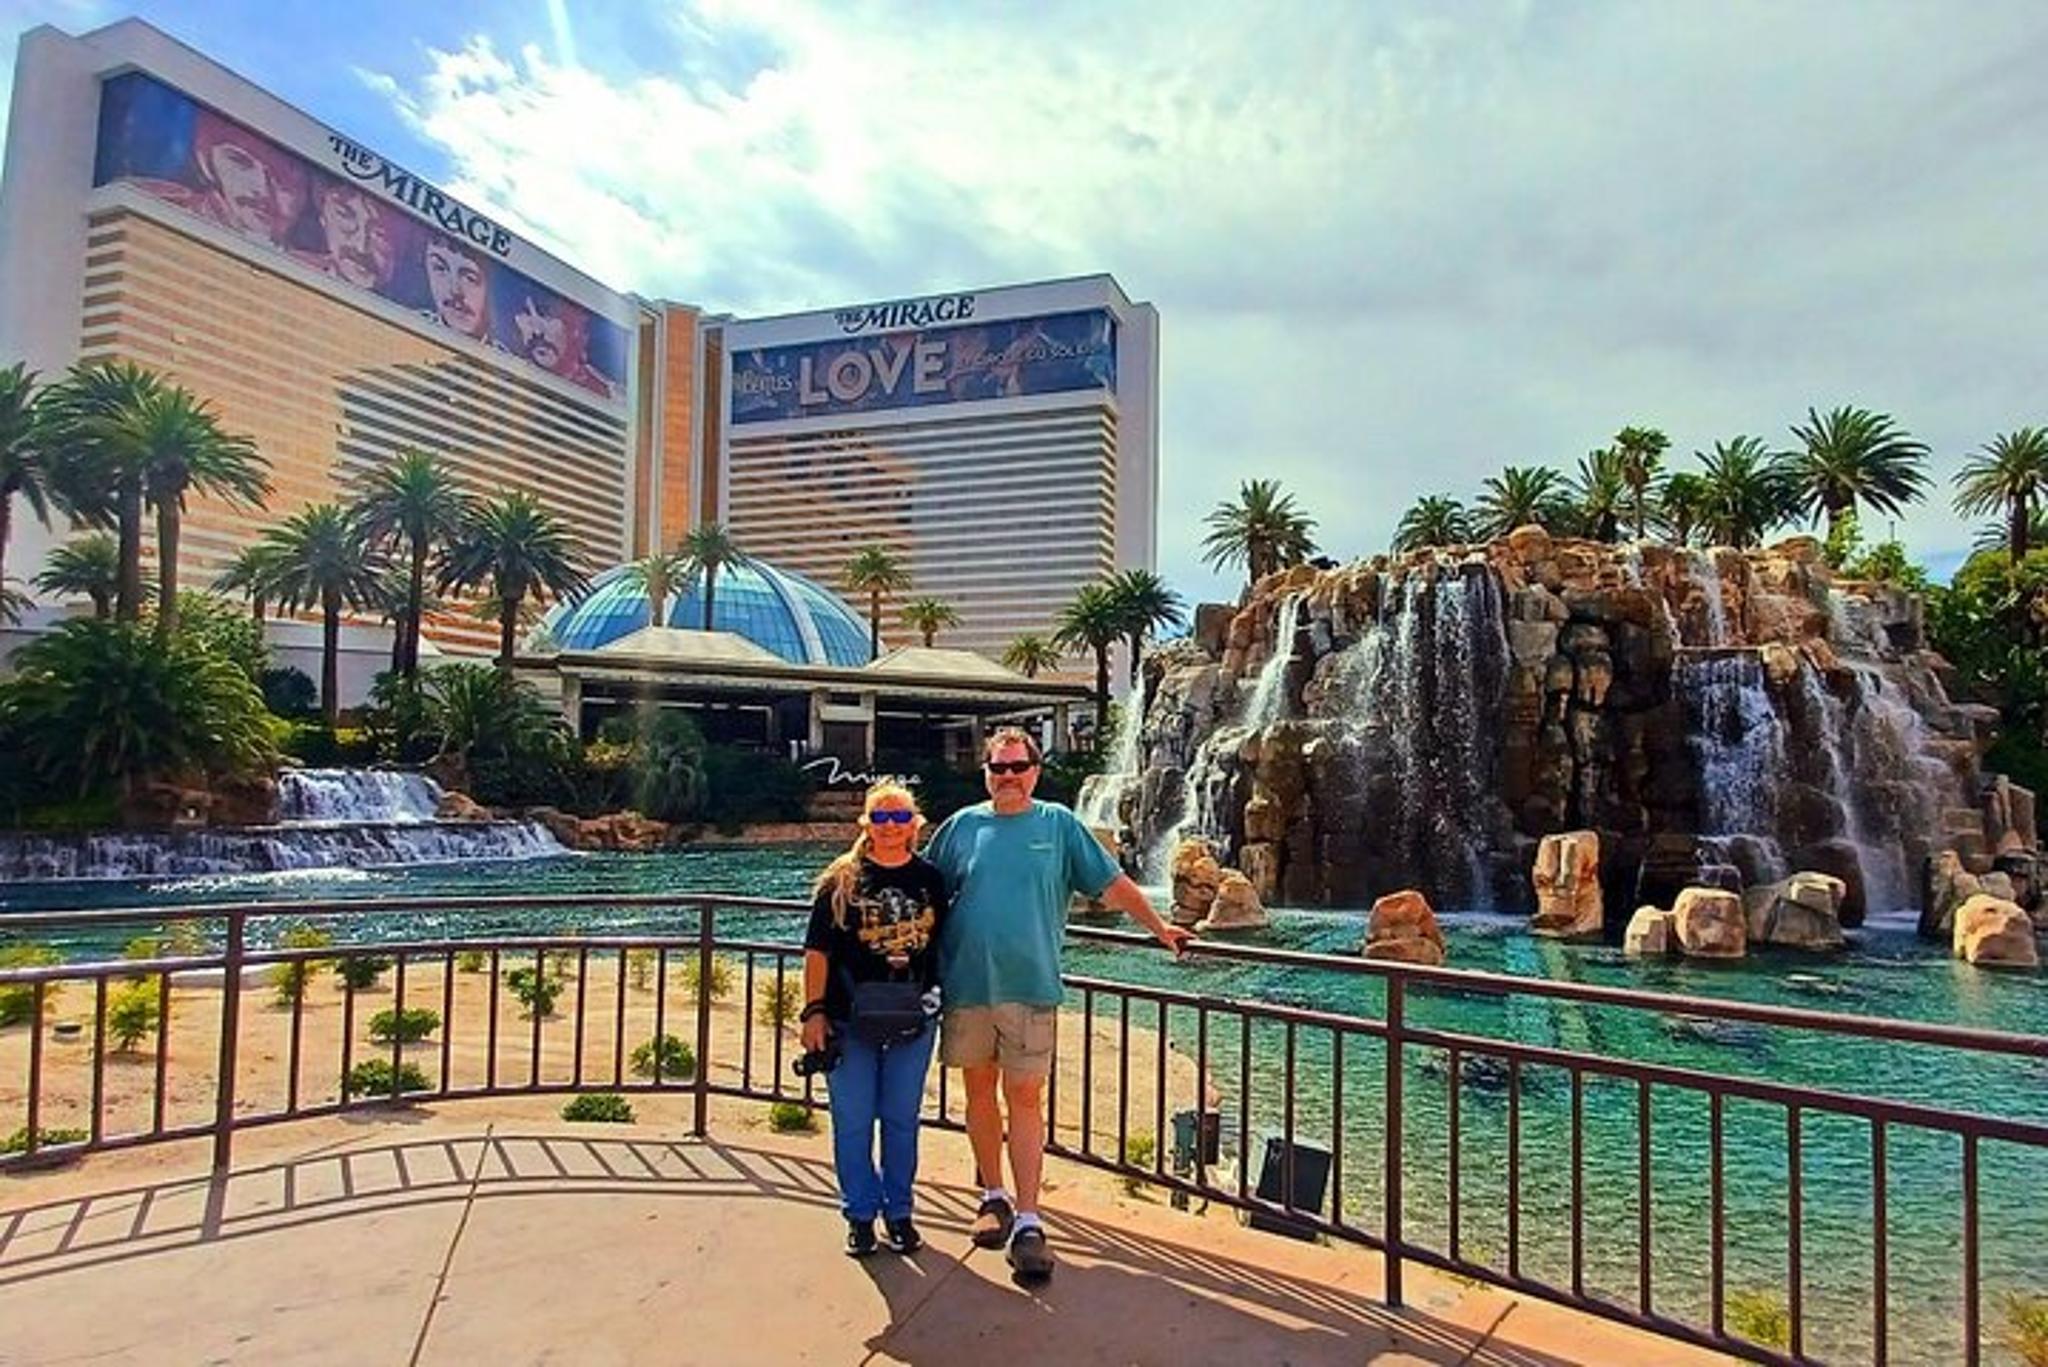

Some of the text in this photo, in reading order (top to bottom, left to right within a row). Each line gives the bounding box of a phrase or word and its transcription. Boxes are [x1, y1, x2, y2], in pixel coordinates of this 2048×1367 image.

[329, 135, 512, 258] THE MIRAGE
[834, 296, 976, 333] THE MIRAGE
[801, 337, 948, 404] LOVE
